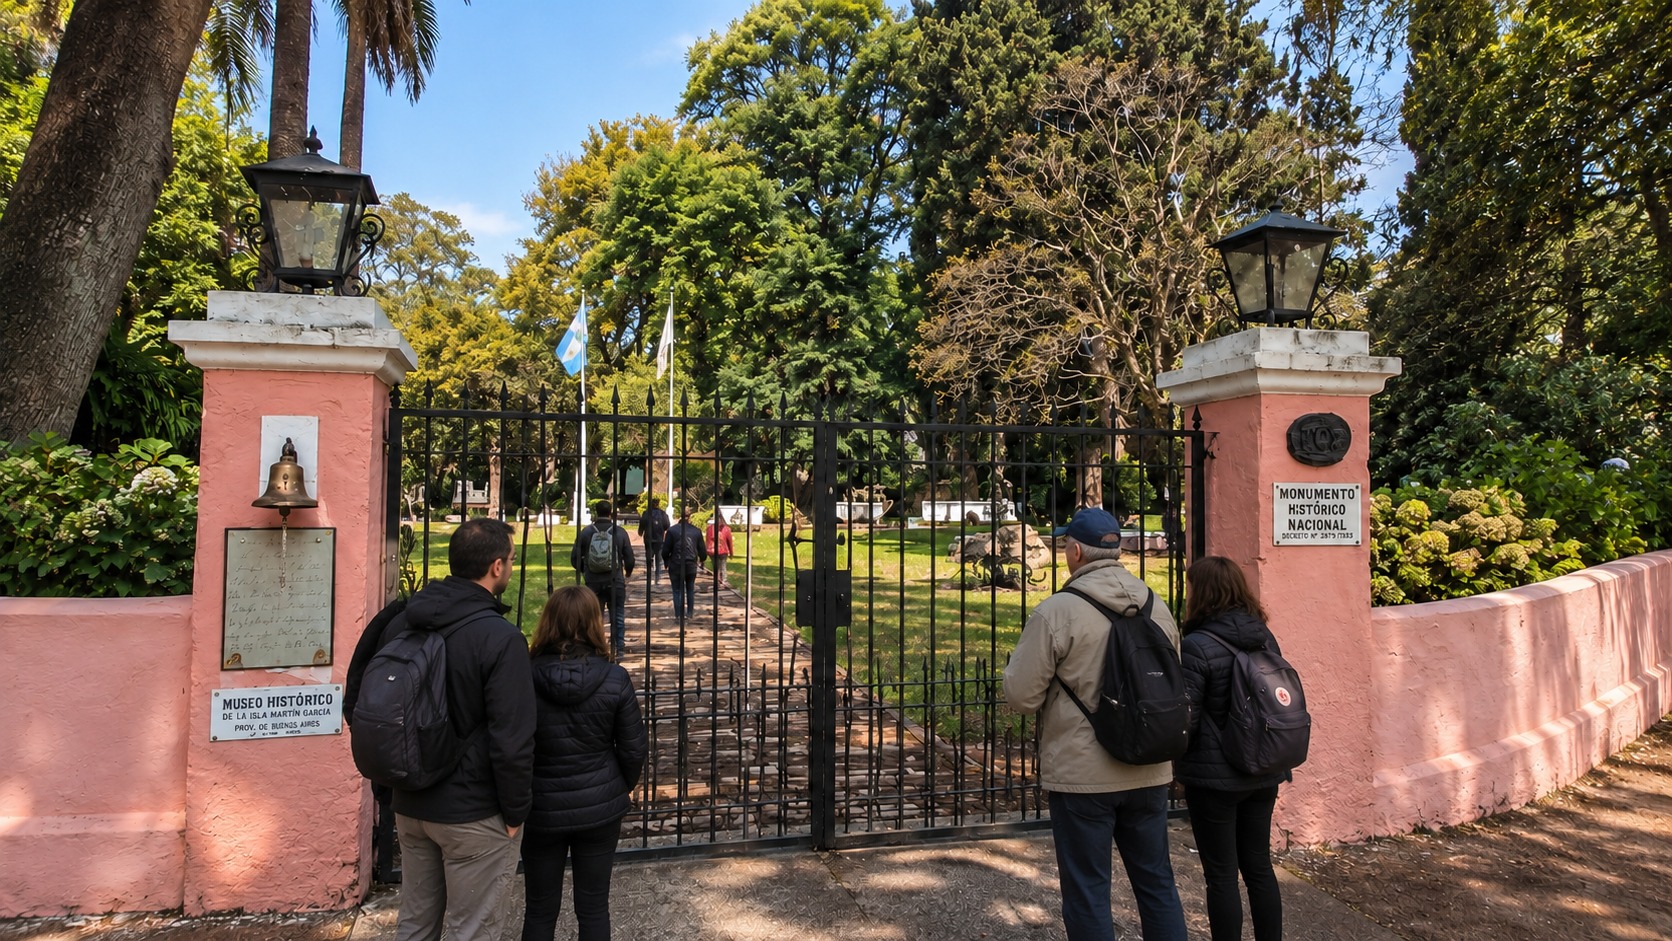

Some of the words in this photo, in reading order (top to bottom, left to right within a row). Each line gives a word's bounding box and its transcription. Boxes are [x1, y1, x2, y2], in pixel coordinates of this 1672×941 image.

[1279, 488, 1355, 500] MONUMENTO
[1288, 500, 1346, 515] HISTÓRICO
[1288, 518, 1347, 531] NACIONAL
[222, 697, 263, 710] MUSEO
[267, 692, 333, 708] HISTÓRICO
[222, 712, 233, 720] DE
[236, 712, 247, 720] LA
[250, 711, 267, 719] ISLA
[270, 709, 300, 718] MARTÍN
[303, 708, 331, 716] GARCÍA
[234, 724, 256, 732] PROV.
